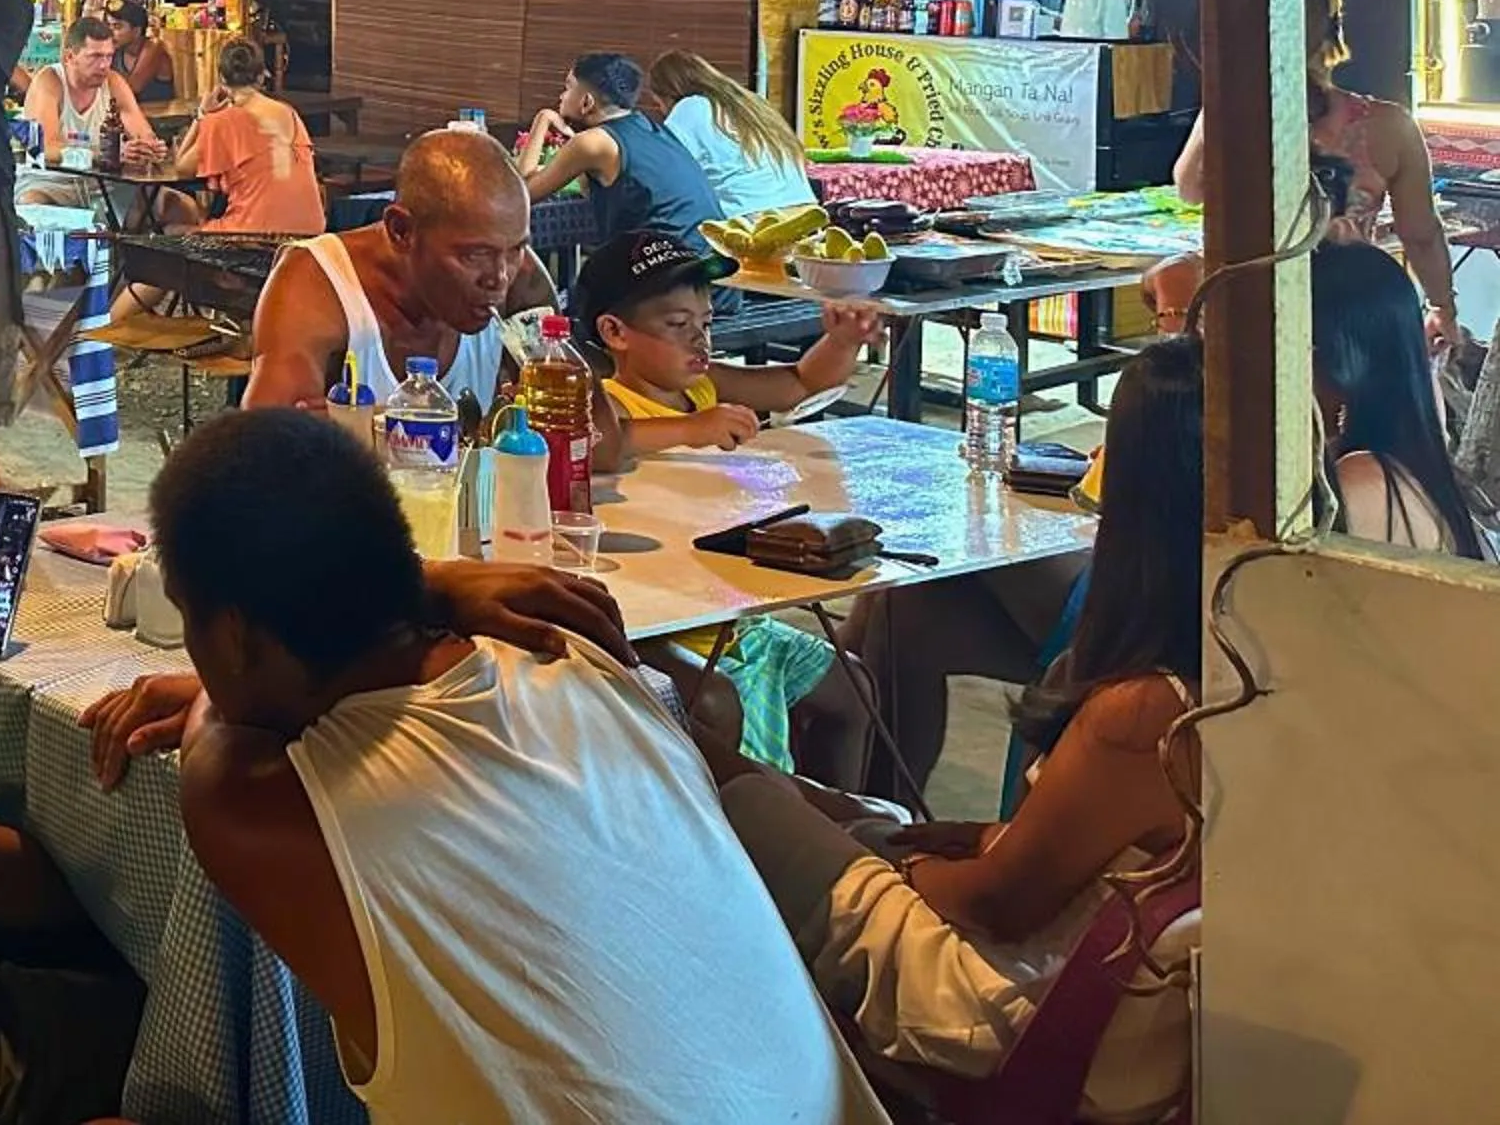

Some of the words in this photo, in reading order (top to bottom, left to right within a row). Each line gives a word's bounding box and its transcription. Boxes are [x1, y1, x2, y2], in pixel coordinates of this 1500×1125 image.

[808, 49, 852, 116] Sizzling
[849, 42, 905, 63] House
[917, 70, 945, 122] Fried
[950, 78, 1013, 101] Mangan
[1020, 82, 1038, 100] Ta
